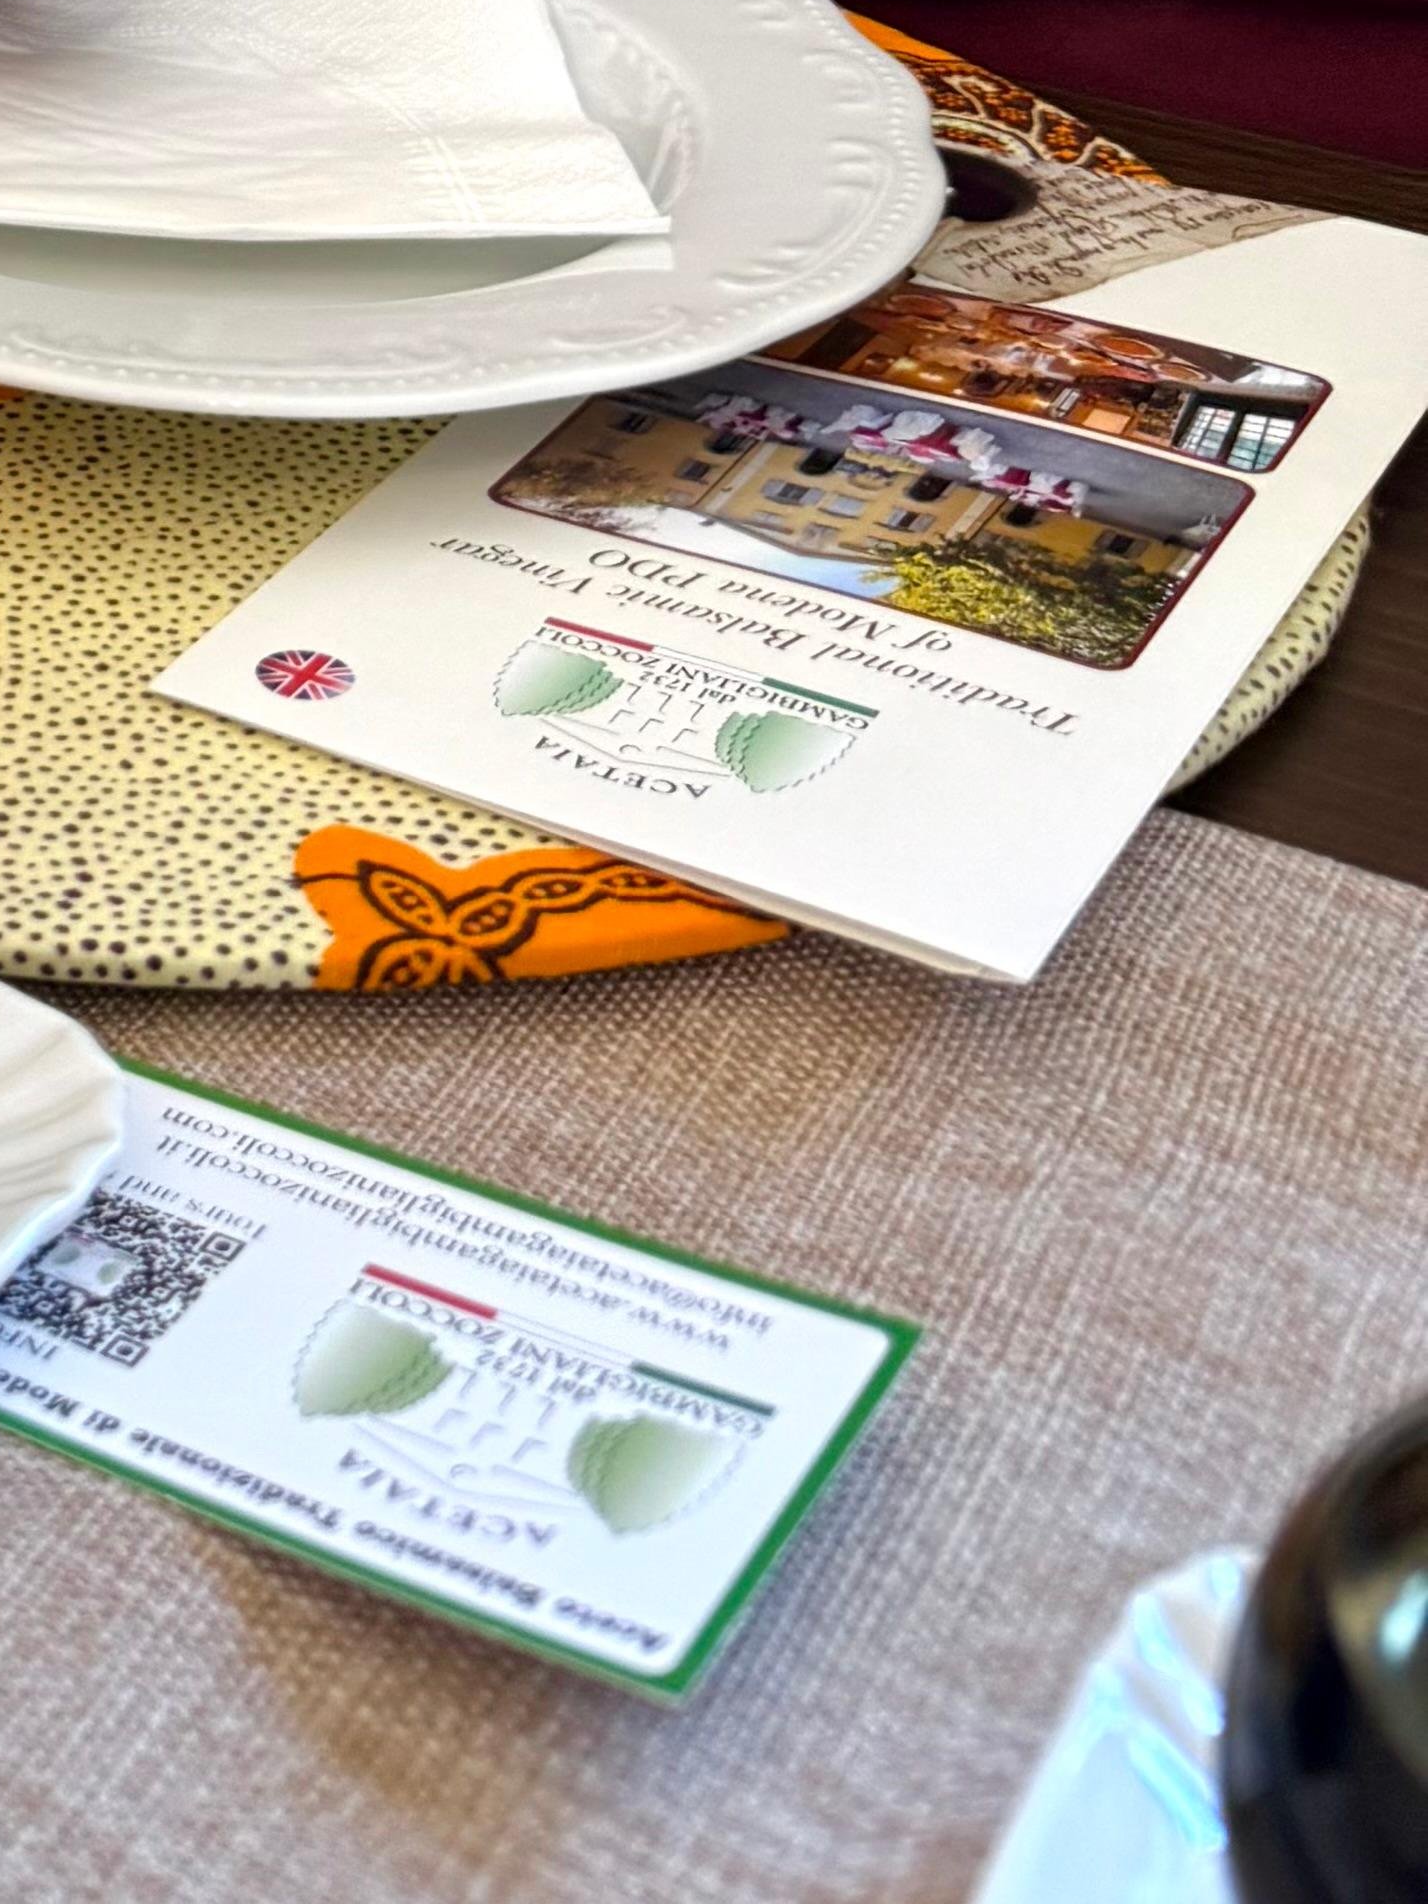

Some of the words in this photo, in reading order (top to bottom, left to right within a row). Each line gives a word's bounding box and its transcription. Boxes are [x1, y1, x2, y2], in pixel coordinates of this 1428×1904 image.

[428, 534, 601, 599] Vinegar
[584, 544, 710, 590] PDO
[604, 580, 813, 654] Balsamic
[718, 576, 899, 642] Modena
[533, 624, 667, 670] ZOCCOLI
[890, 631, 955, 659] of
[638, 670, 698, 701] 1732
[663, 657, 872, 733] GAMBIGLIANI
[699, 686, 740, 706] dal
[805, 639, 1079, 739] Traditional
[531, 733, 714, 801] ACETAIA
[348, 1276, 508, 1345] ZOCCOLI
[82, 1407, 123, 1434] di
[509, 1335, 768, 1440] GAMBIGLIANI
[129, 1425, 349, 1534] Tradizionale
[338, 1446, 560, 1548] ACETAIA
